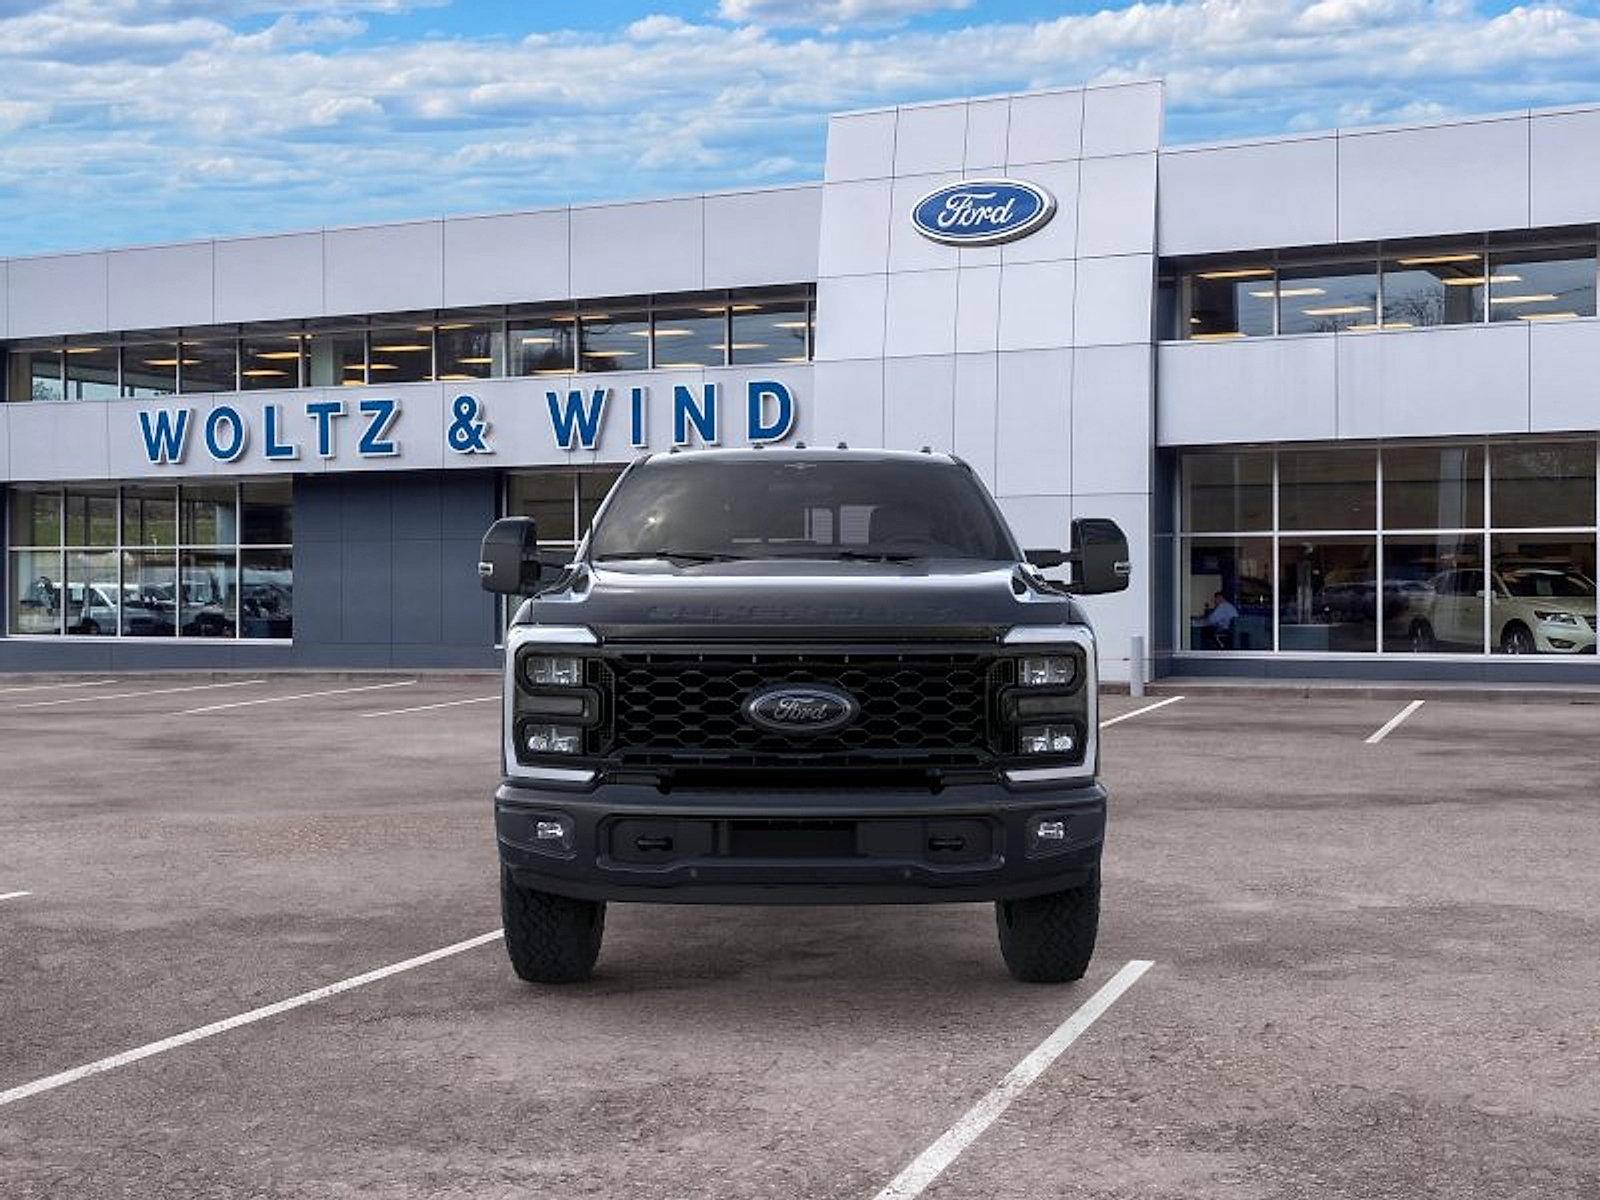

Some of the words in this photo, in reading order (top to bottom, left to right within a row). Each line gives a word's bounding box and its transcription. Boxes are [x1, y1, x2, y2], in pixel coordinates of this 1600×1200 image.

[937, 192, 1015, 227] Ford
[139, 399, 400, 464] WOLTZ
[448, 394, 494, 454] &
[545, 379, 797, 449] WIND
[774, 698, 828, 719] Ford
